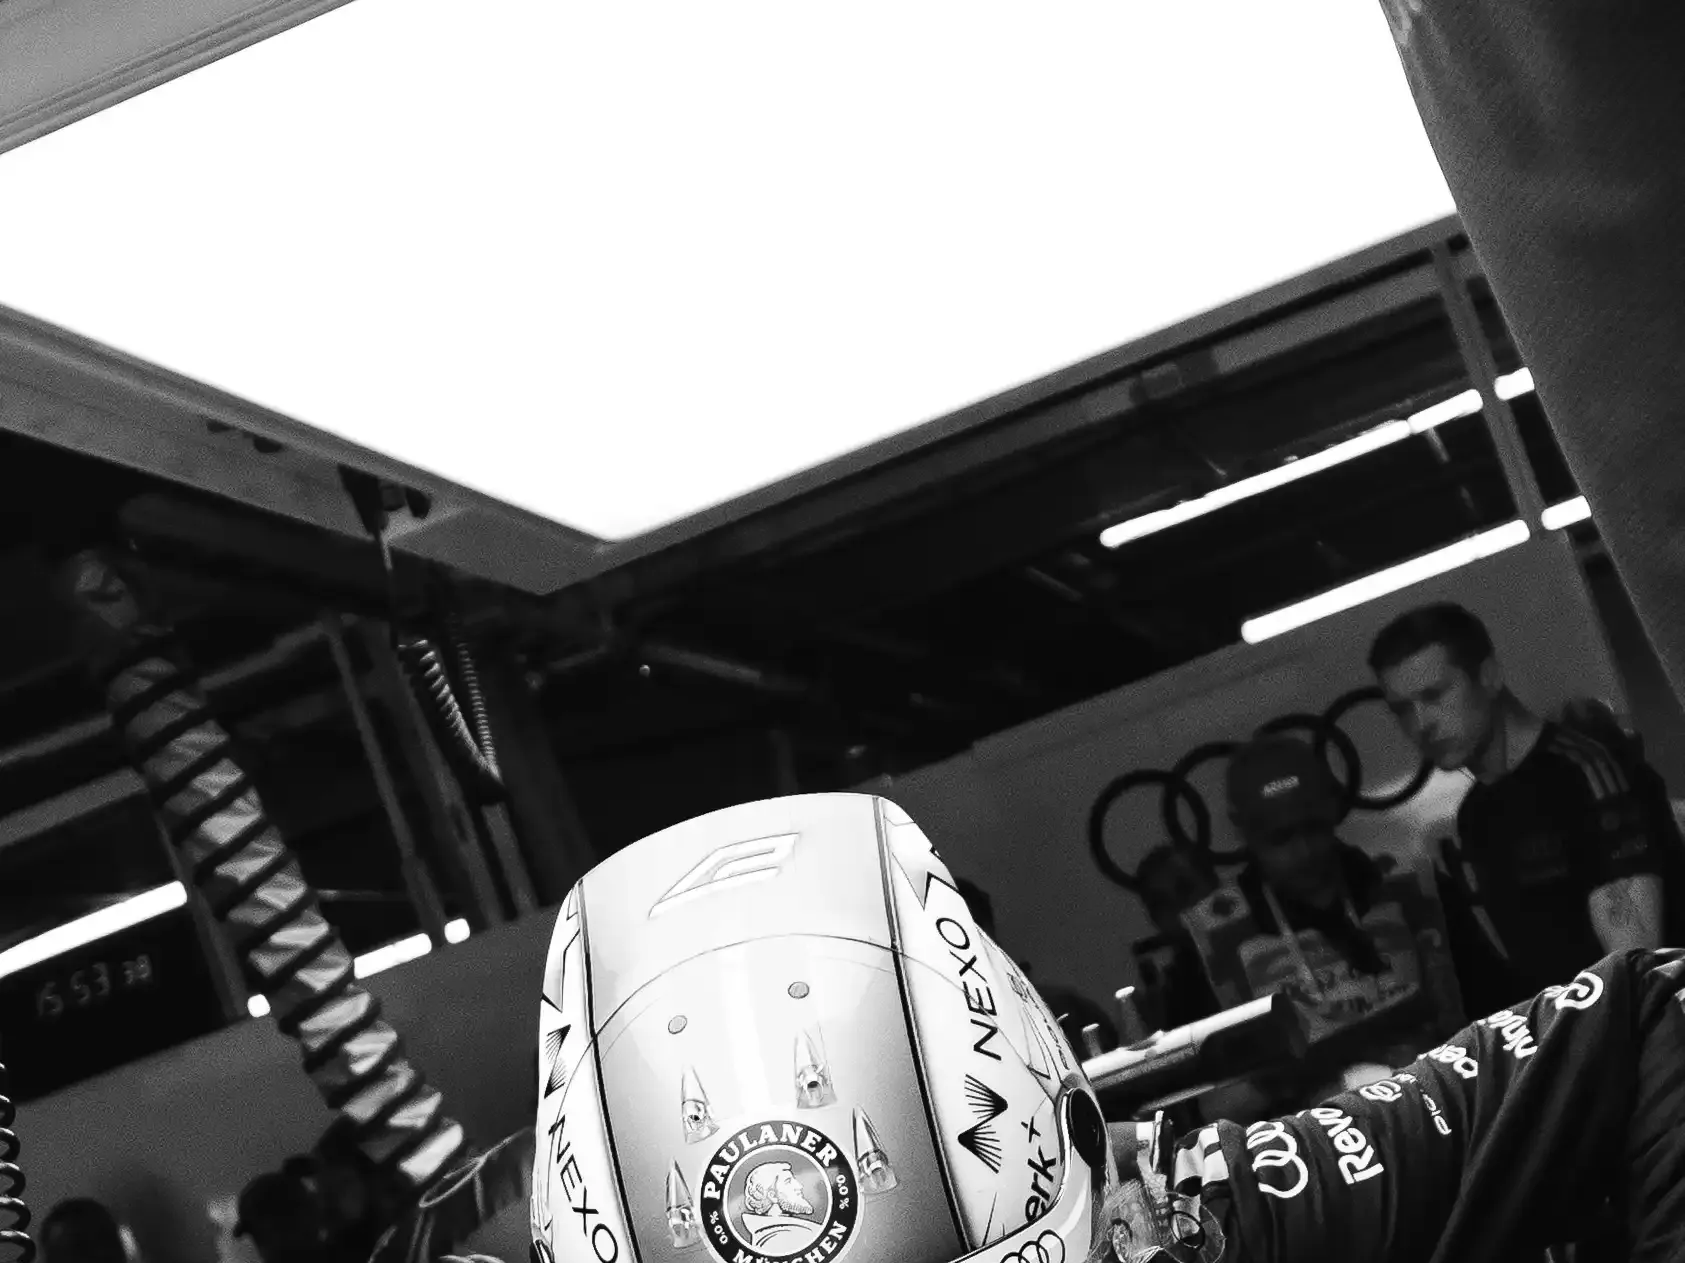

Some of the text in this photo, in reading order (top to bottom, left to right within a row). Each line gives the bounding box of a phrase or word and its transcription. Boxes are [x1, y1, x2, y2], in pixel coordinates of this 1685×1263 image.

[935, 917, 1002, 1061] NEXO
[704, 1123, 837, 1200] PAULANER
[1296, 1107, 1384, 1185] Revo
